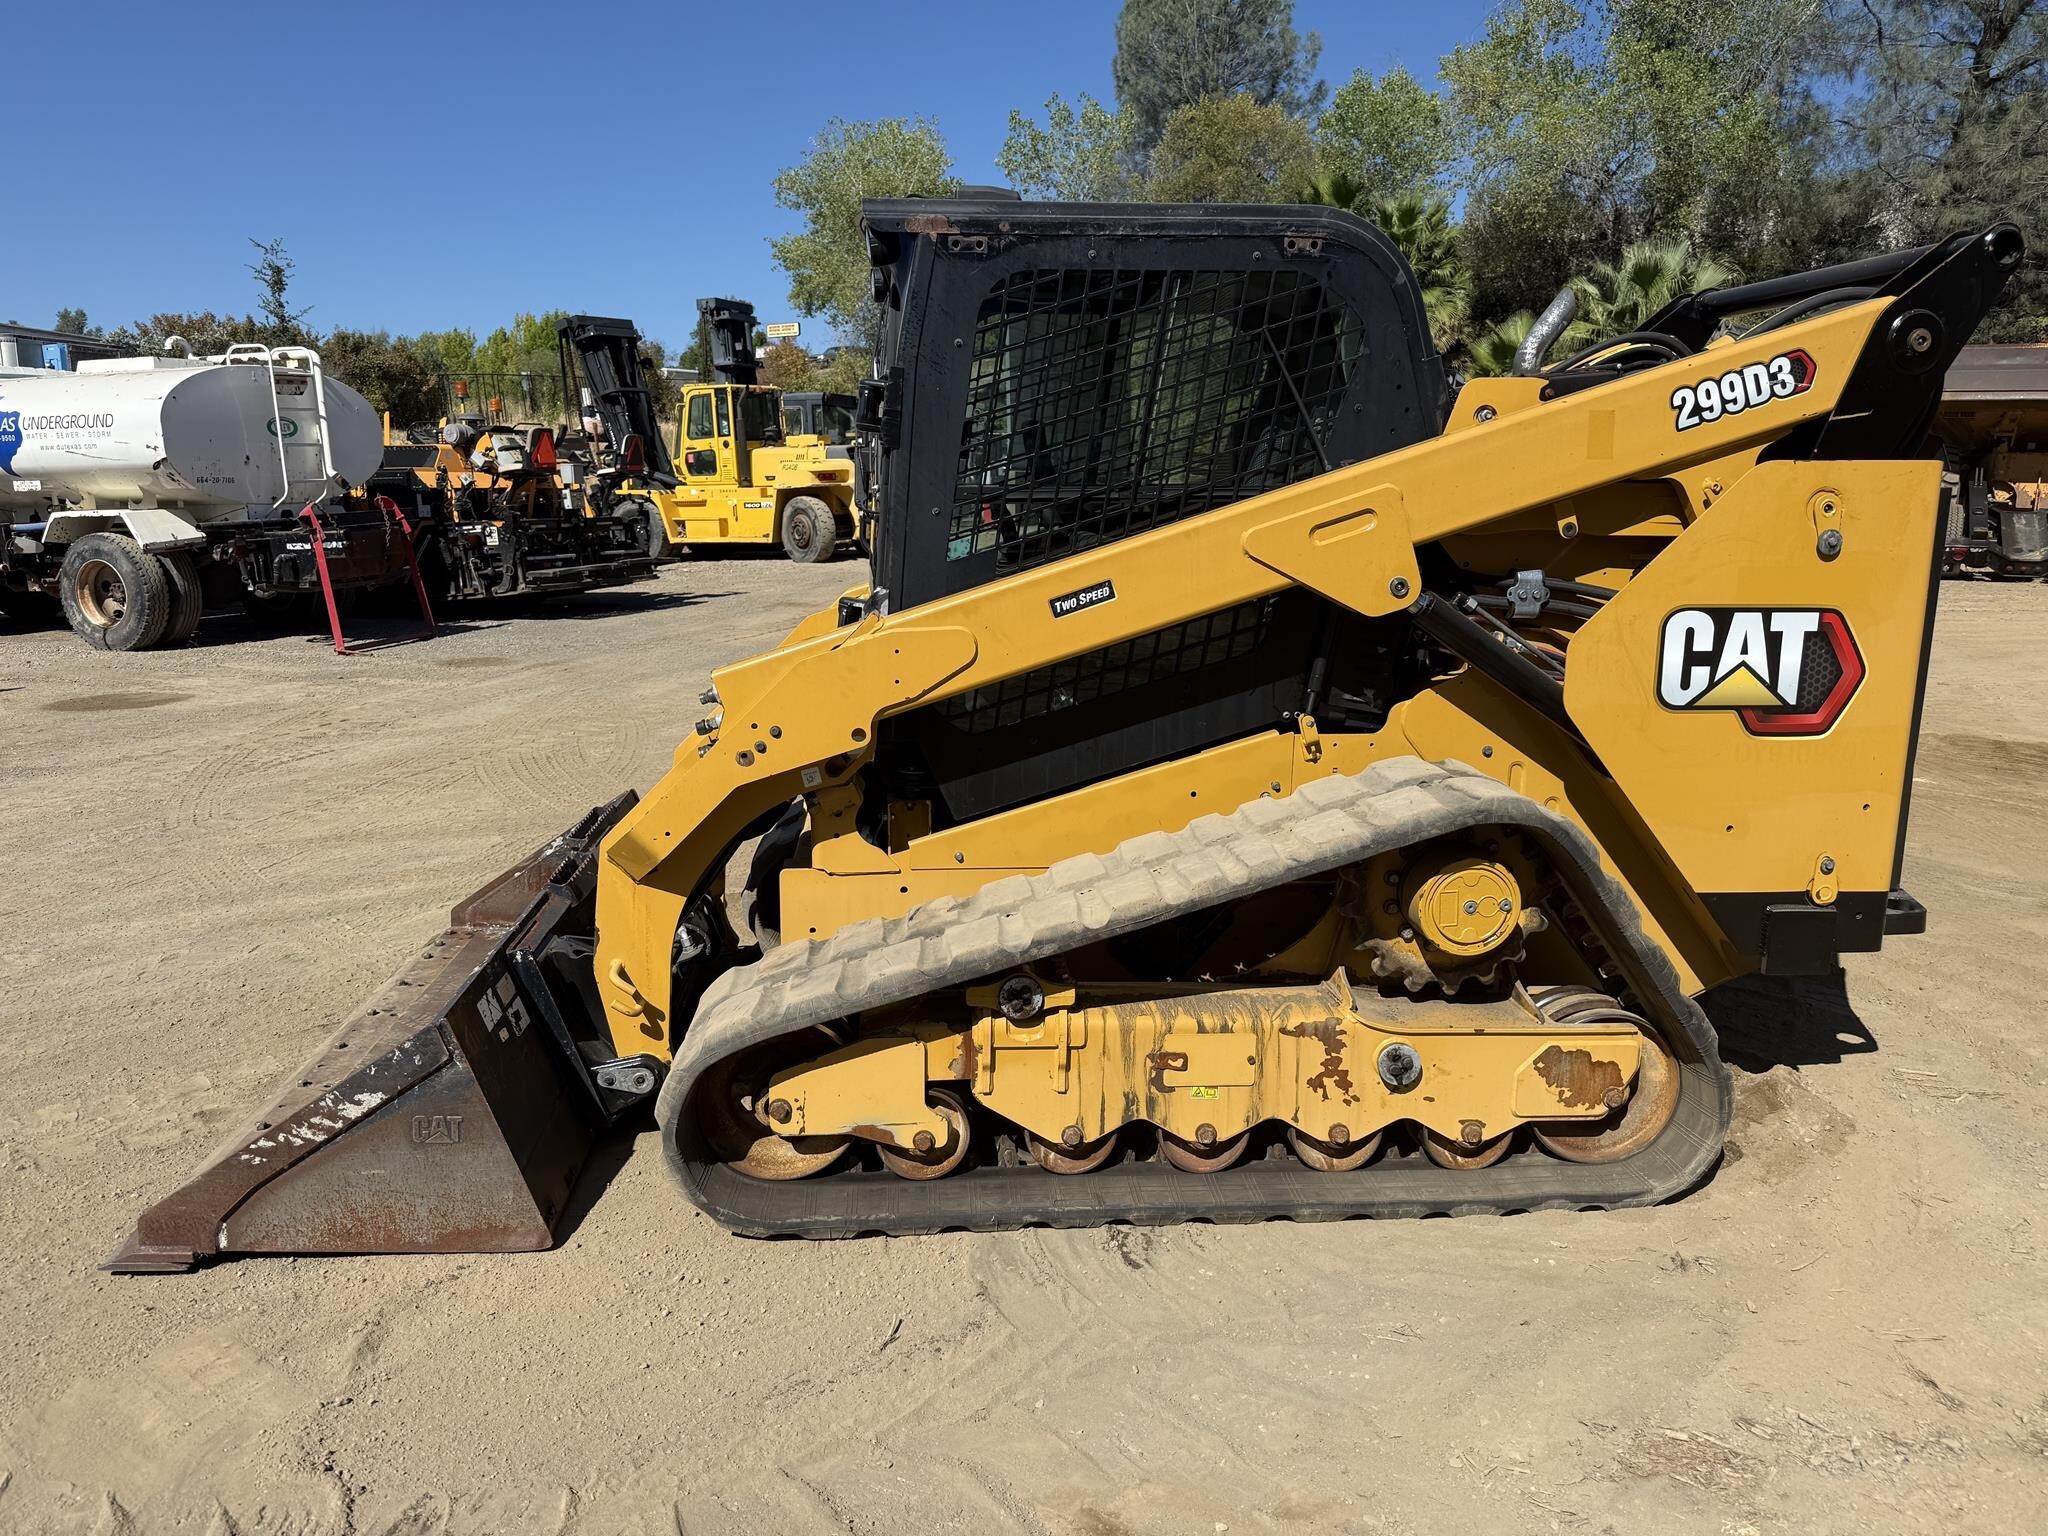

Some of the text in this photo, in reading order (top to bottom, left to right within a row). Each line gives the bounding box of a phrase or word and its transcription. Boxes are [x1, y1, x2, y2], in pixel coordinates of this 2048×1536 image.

[1672, 355, 1796, 430] 299D3
[22, 413, 114, 431] UNDERGROUND
[26, 430, 112, 440] WATER SEWER STORM
[1079, 586, 1110, 605] SPEED
[1660, 610, 1820, 706] CAT
[412, 1115, 464, 1144] CAT
